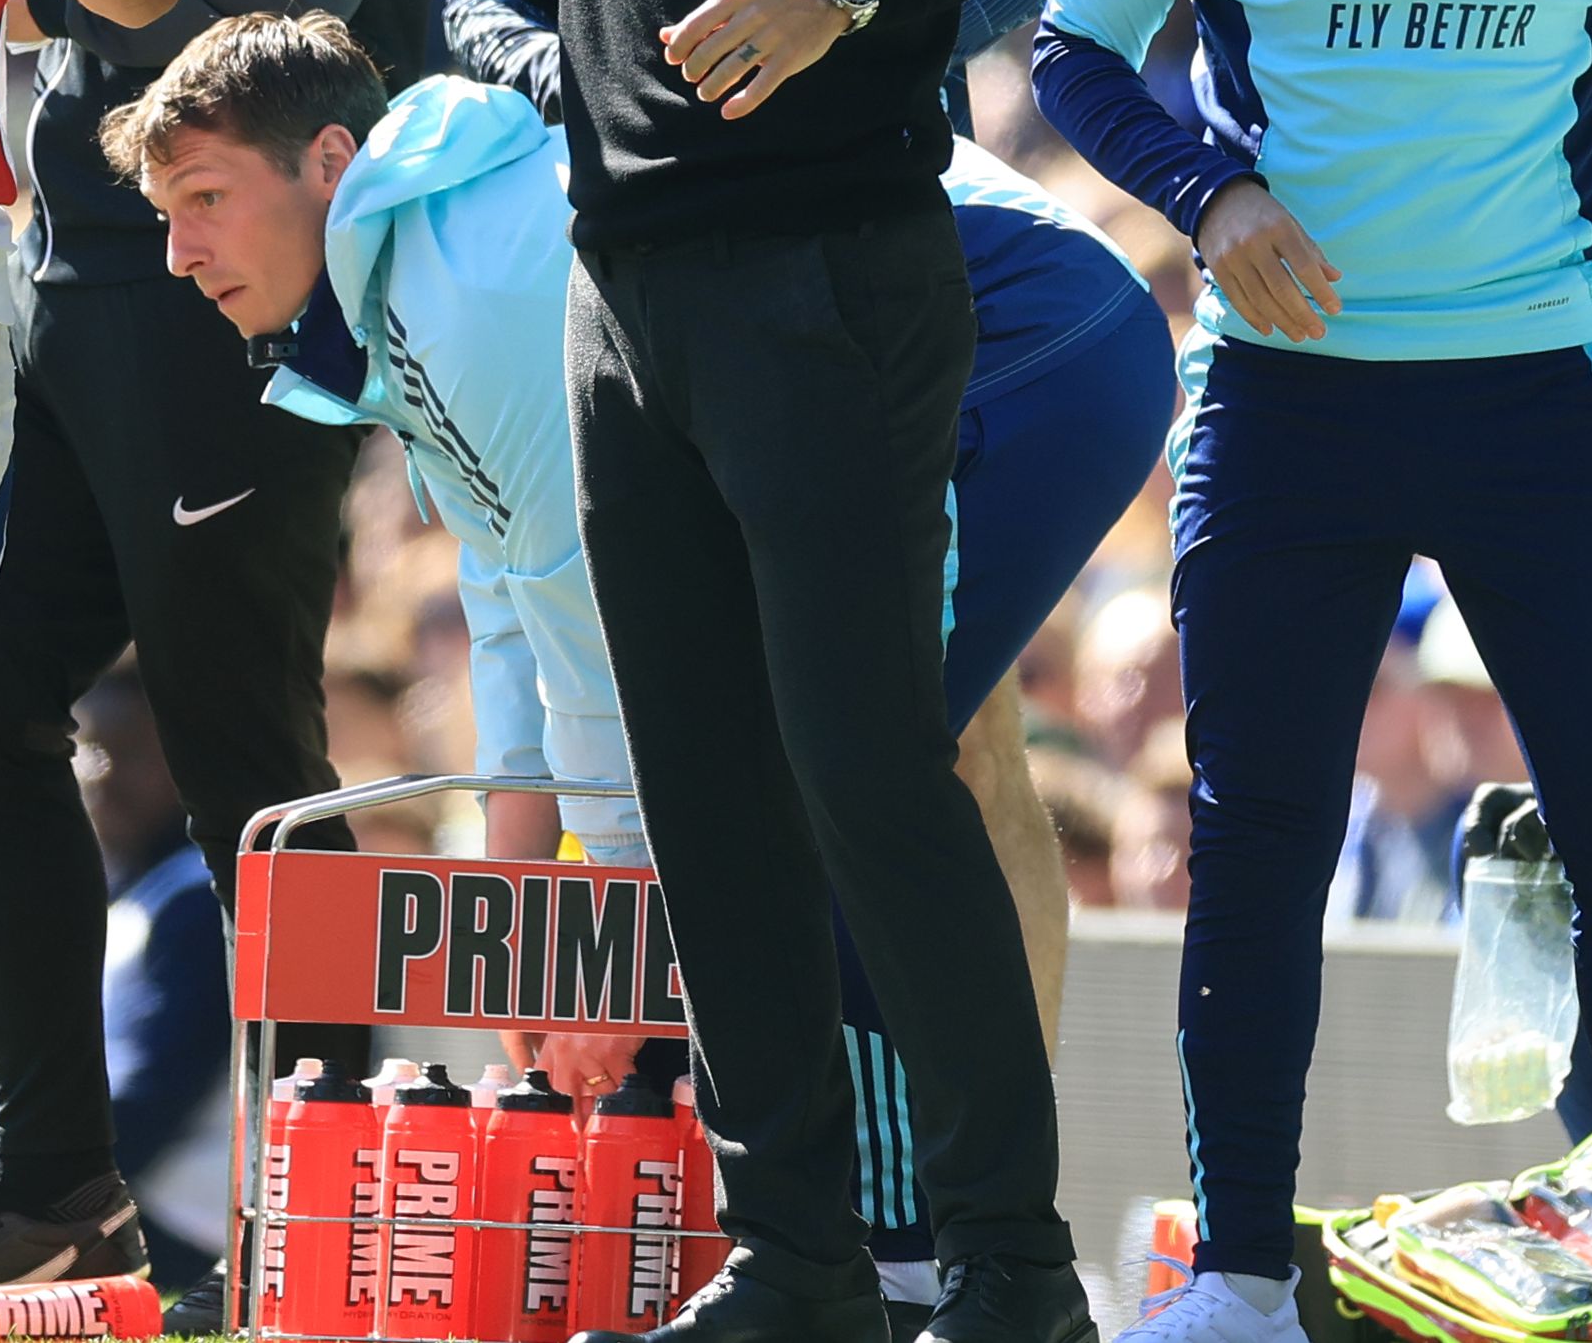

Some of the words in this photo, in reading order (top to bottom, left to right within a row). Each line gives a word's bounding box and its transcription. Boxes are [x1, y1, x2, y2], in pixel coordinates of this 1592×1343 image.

[1326, 2, 1391, 49] FLY
[1404, 2, 1536, 49] BETTER
[388, 1149, 460, 1307] PRIME
[524, 1156, 577, 1314] PRIME
[629, 1160, 677, 1318] PRIME
